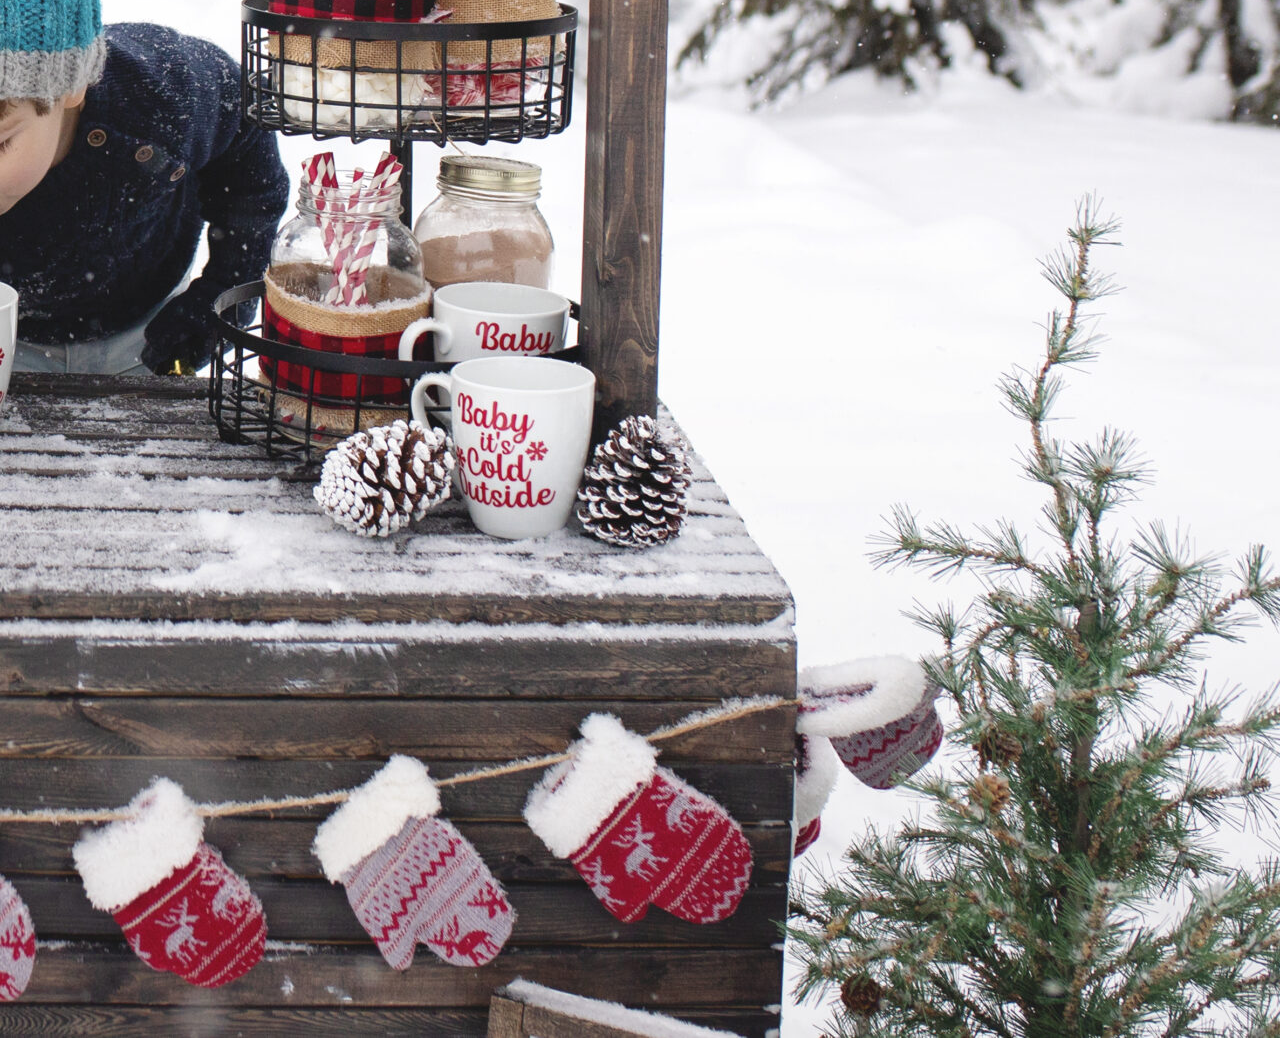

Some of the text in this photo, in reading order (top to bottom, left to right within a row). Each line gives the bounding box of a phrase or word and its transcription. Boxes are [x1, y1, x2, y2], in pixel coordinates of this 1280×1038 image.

[475, 321, 556, 354] Baby
[457, 392, 535, 444] Baby
[480, 431, 515, 456] it's
[466, 447, 532, 483] Cold
[460, 467, 557, 509] Outside
